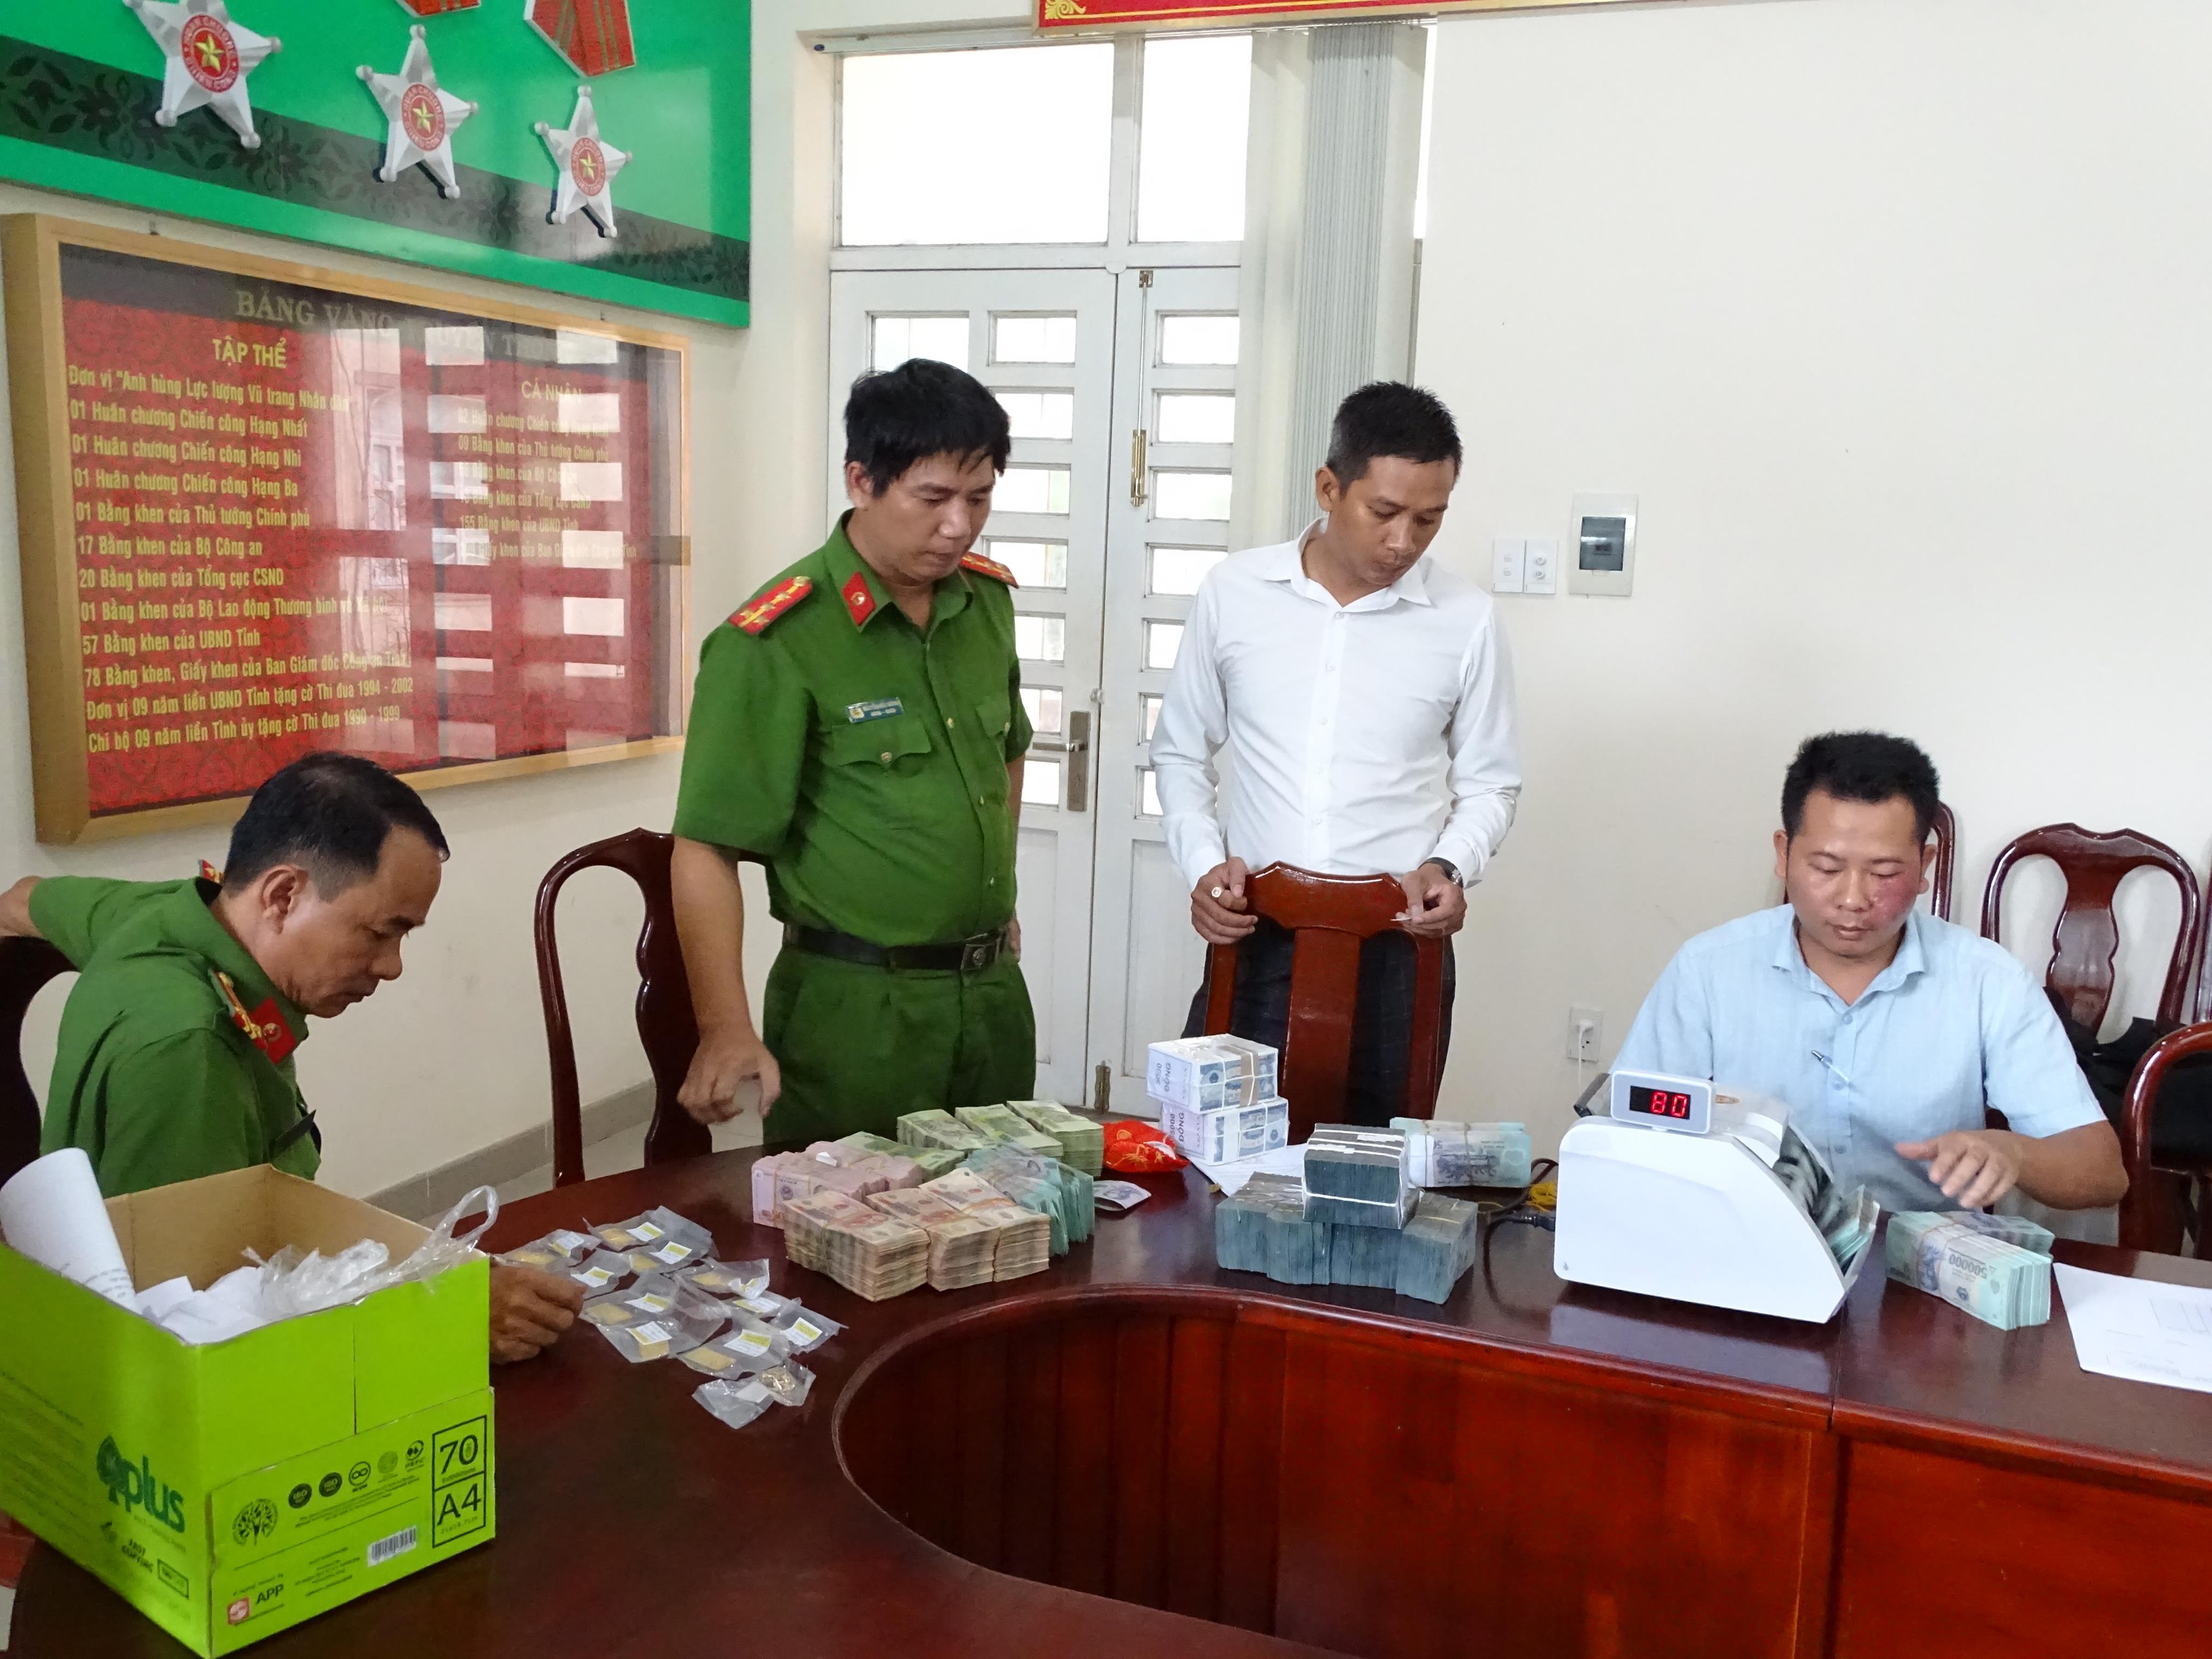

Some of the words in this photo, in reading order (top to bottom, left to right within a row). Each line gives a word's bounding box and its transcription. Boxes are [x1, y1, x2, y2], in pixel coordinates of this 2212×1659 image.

[213, 335, 248, 366] TẬP
[253, 337, 286, 369] THỂ
[151, 374, 181, 399] hùng
[186, 377, 207, 400] Lực
[212, 380, 243, 406] lượng
[267, 388, 295, 410] trang
[299, 389, 326, 409] Nhân
[70, 399, 85, 419] 01
[92, 401, 126, 423] Huân
[131, 405, 176, 430] chương
[180, 408, 214, 430] Chiến
[219, 414, 245, 437] công
[250, 415, 278, 439] Hạng
[282, 417, 307, 437] Nhất
[72, 434, 87, 454] 01
[93, 435, 127, 456] Huân
[133, 438, 176, 463] chương
[181, 440, 215, 462] Chiến
[219, 445, 246, 467] công
[251, 446, 279, 469] Hạng
[459, 435, 469, 450] 09
[496, 437, 515, 455] khen
[74, 467, 89, 487] 01
[96, 468, 130, 488] Huân
[134, 471, 178, 495] chương
[183, 472, 216, 493] Chiến
[221, 476, 247, 497] công
[252, 477, 280, 499] Hạng
[285, 478, 298, 497] Ba
[76, 502, 91, 521] 01
[98, 499, 130, 526] Bằng
[134, 503, 164, 523] khen
[168, 503, 190, 524] của
[194, 503, 215, 524] Thủ
[220, 507, 252, 529] tướng
[257, 507, 287, 526] Chính
[291, 508, 309, 530] phủ
[78, 535, 93, 555] 17
[98, 532, 131, 559] Bằng
[137, 536, 165, 555] khen
[170, 535, 191, 555] của
[196, 536, 211, 558] Bộ
[216, 537, 244, 559] Công
[249, 542, 262, 555] an
[79, 568, 95, 588] 20
[100, 565, 132, 591] Bằng
[138, 569, 166, 587] khen
[171, 566, 192, 587] của
[197, 564, 225, 590] Tổng
[230, 572, 249, 589] cục
[253, 568, 284, 586] CSND
[81, 602, 96, 621] 01
[102, 597, 134, 624] Bằng
[139, 601, 168, 619] khen
[173, 598, 194, 618] của
[199, 599, 213, 621] Bộ
[219, 599, 238, 617] Lao
[244, 598, 270, 619] động
[274, 598, 312, 618] Thương
[316, 596, 337, 613] binh
[82, 635, 99, 655] 57
[104, 630, 136, 657] Bằng
[140, 633, 169, 651] khen
[174, 629, 195, 650] của
[199, 629, 232, 648] UBND
[237, 627, 260, 646] Tỉnh
[85, 667, 100, 687] 78
[105, 663, 138, 689] Bằng
[142, 665, 176, 684] khen,
[180, 659, 207, 683] Giấy
[211, 660, 238, 679] khen
[242, 657, 262, 677] của
[266, 657, 286, 675] Ban
[290, 655, 318, 673] Giám
[321, 652, 339, 671] đốc
[86, 700, 112, 720] Đơn
[117, 699, 129, 720] vị
[132, 697, 148, 717] 09
[152, 696, 179, 714] năm
[210, 690, 242, 709] UBND
[247, 687, 270, 706] Tỉnh
[274, 687, 297, 707] tặng
[301, 684, 313, 702] cờ
[317, 683, 333, 700] Thi
[336, 683, 354, 698] đua
[358, 679, 381, 697] 1994
[391, 677, 414, 694] 2002
[114, 731, 130, 752] bộ
[135, 729, 150, 748] 09
[154, 727, 181, 746] năm
[212, 720, 237, 739] Tỉnh
[241, 717, 254, 740] ủy
[258, 718, 281, 738] tặng
[286, 714, 298, 732] cờ
[302, 713, 318, 730] Thi
[322, 712, 340, 728] đua
[344, 708, 367, 726] 1990
[379, 705, 400, 722] 1999
[1650, 1092, 1687, 1117] 80
[1949, 1254, 1987, 1279] 500000
[440, 1434, 478, 1474] 70
[437, 1483, 481, 1526] A4
[256, 1583, 284, 1604] APP
